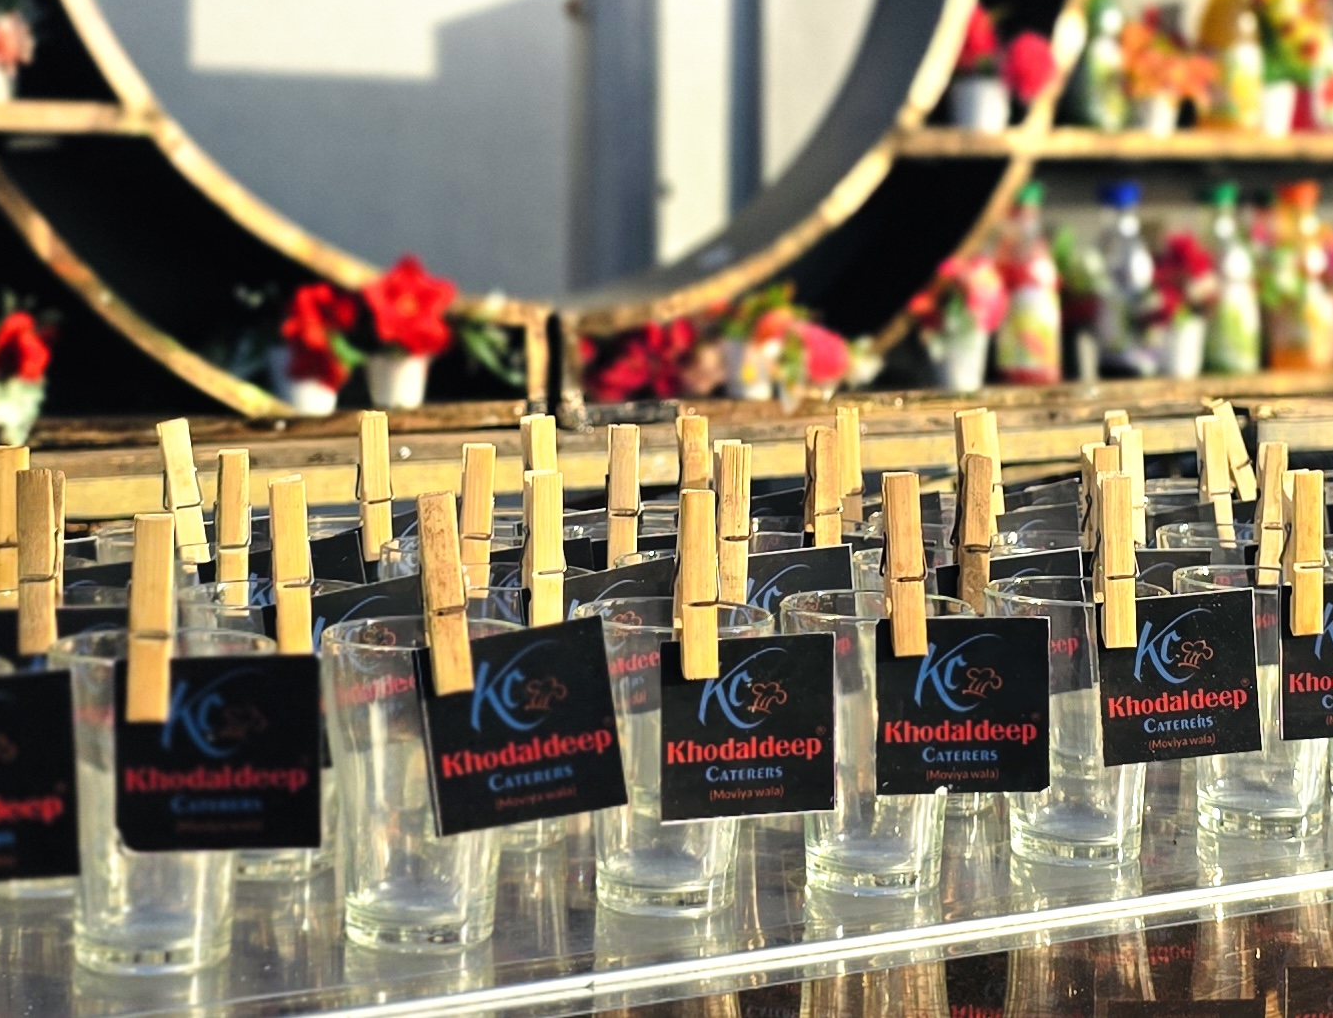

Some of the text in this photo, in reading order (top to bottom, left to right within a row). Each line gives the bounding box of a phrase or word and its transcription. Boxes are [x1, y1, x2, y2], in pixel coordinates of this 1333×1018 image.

[1133, 609, 1199, 684] KC
[471, 641, 543, 733] KC
[698, 648, 773, 729] KC
[914, 634, 986, 713] KC
[161, 670, 243, 758] KC
[1108, 687, 1248, 719] Khodaldeep
[884, 719, 1038, 745] Khodaldeep
[1143, 714, 1215, 733] CATERERS
[440, 727, 614, 780] Khodaldeep
[667, 734, 823, 765] Khodaldeep
[922, 746, 999, 763] CATERERS
[1148, 733, 1216, 751] (Moviya wala)
[124, 764, 309, 793] Khodaldeep
[487, 763, 575, 793] CATERERS
[705, 765, 784, 784] CATERERS
[925, 767, 1000, 784] (Moviya wala)
[709, 783, 785, 803] (Moviya wala)
